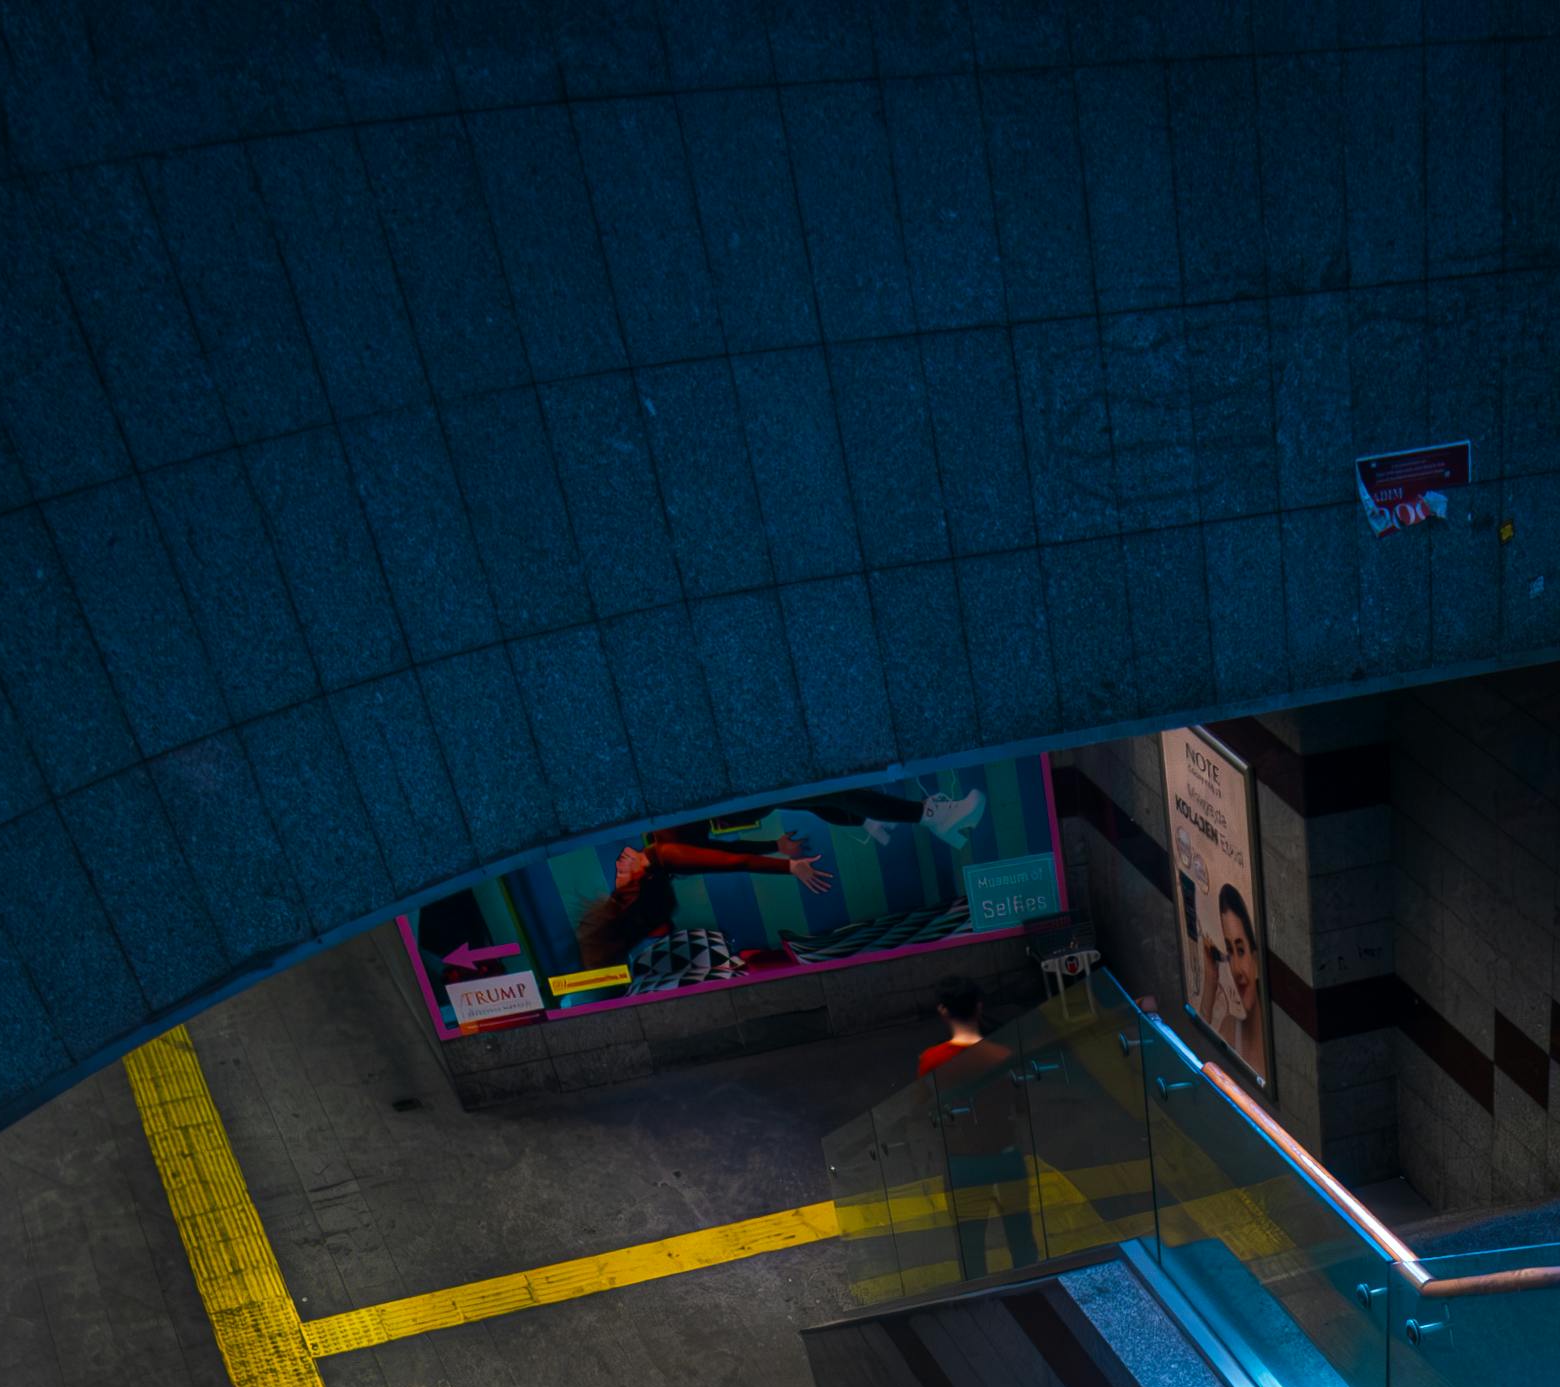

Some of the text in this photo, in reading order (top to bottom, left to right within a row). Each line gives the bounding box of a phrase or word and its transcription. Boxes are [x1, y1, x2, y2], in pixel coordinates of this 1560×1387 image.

[1185, 742, 1220, 786] NOTE
[977, 872, 1028, 889] Museum
[981, 895, 1048, 919] Selfies
[461, 982, 527, 1007] TRUMP
